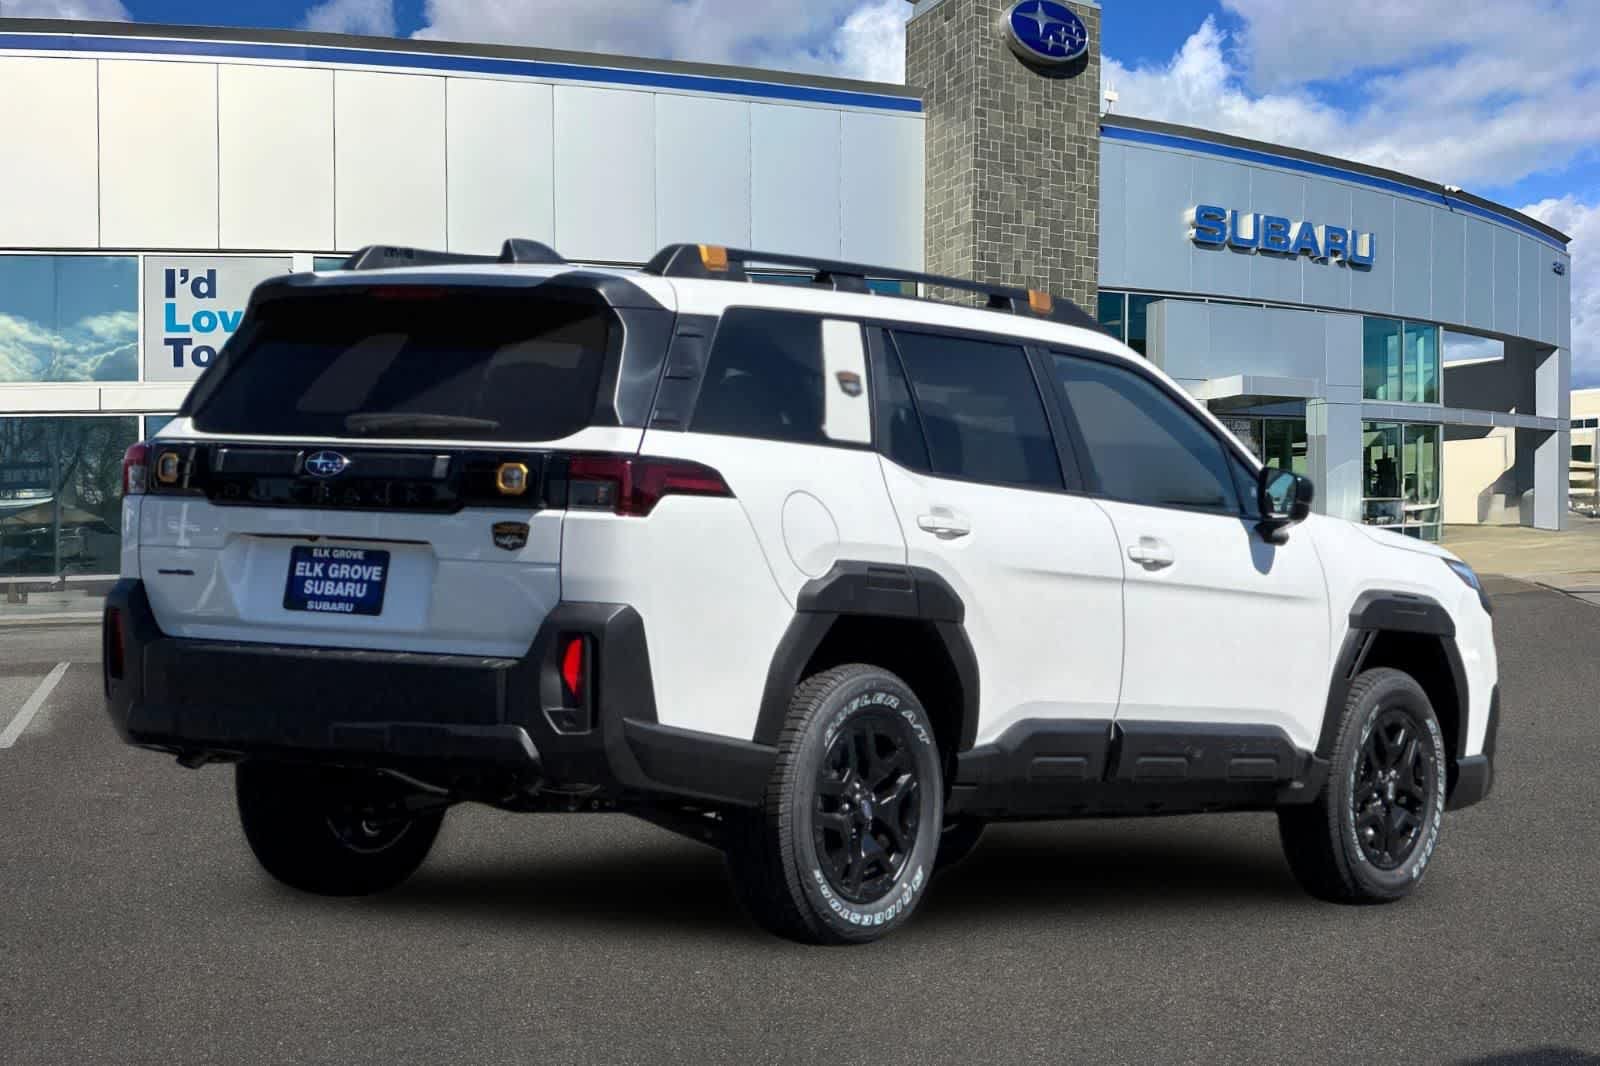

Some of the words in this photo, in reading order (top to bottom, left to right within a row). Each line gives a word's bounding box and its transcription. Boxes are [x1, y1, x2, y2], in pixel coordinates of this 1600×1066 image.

[1191, 204, 1376, 271] SUBARU
[165, 268, 217, 299] I’d
[165, 302, 244, 333] Lov
[164, 337, 217, 368] To
[312, 548, 331, 558] ELK
[332, 550, 365, 560] GROVE
[295, 561, 325, 577] ELK
[328, 564, 382, 581] GROVE
[304, 579, 368, 598] SUBARU
[306, 600, 354, 612] SUBARU
